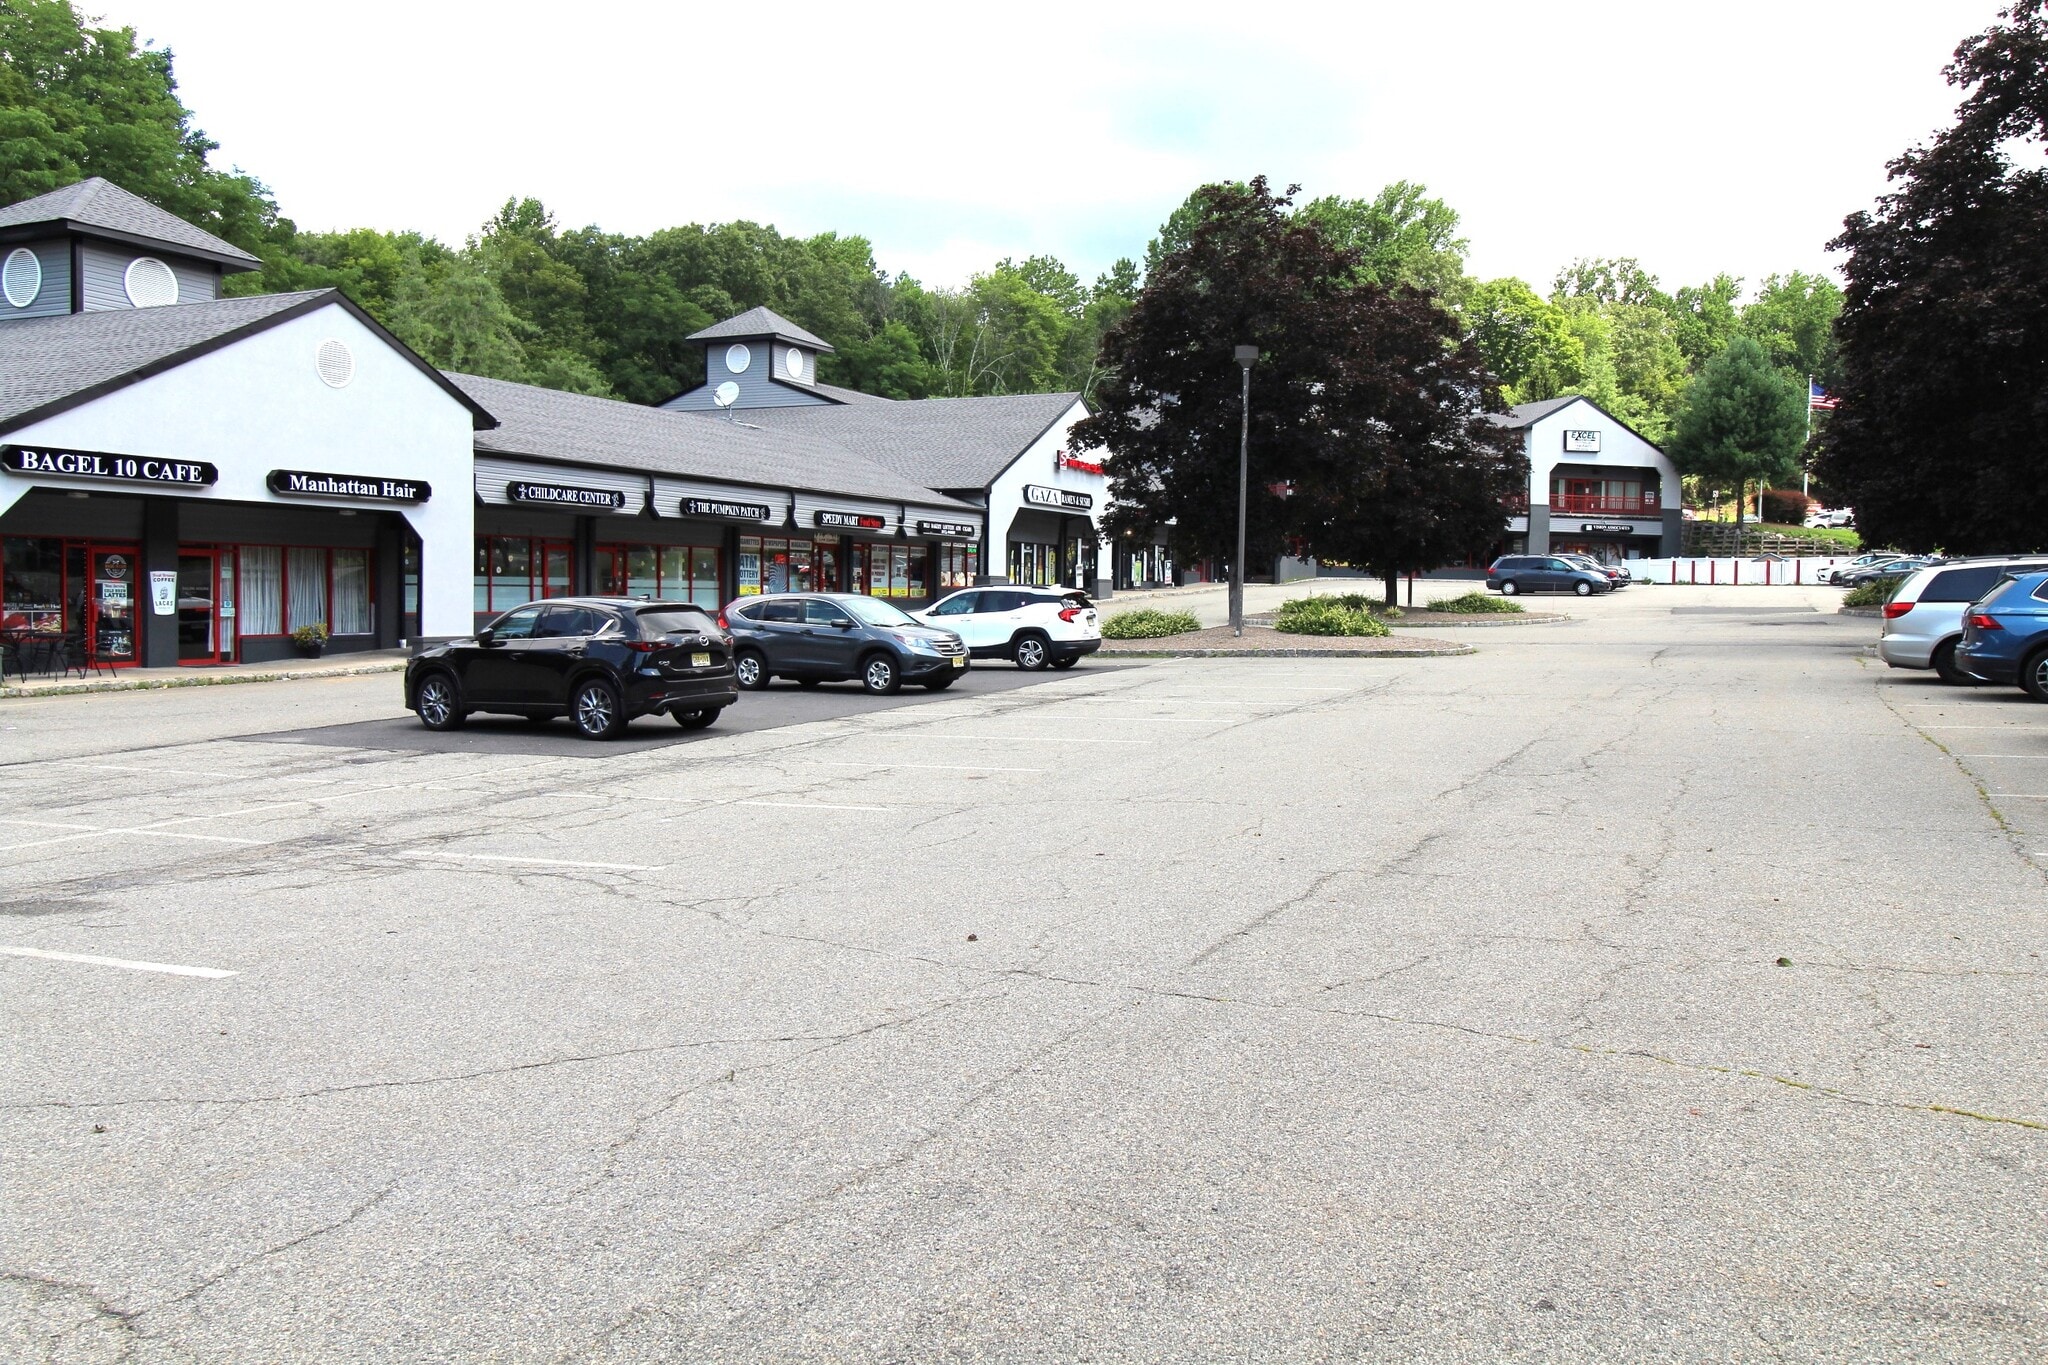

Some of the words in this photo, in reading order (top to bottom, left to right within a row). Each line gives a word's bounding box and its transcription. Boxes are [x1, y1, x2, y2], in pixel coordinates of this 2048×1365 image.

[1571, 431, 1596, 440] EXCEL
[21, 450, 109, 475] BAGEL
[114, 459, 137, 477] 10
[142, 461, 203, 482] CAFE
[290, 474, 378, 496] Manhattan
[382, 481, 416, 498] Hair
[528, 486, 578, 502] CHILDCARE
[580, 490, 611, 505] CENTER
[1031, 487, 1058, 504] GAZA
[697, 502, 710, 513] THE
[711, 503, 740, 516] PUMPKIN
[740, 506, 760, 518] PATCH
[822, 513, 843, 525] SPEEDY
[843, 515, 859, 526] MART
[740, 555, 758, 568] ATM
[740, 570, 758, 579] OTTERY
